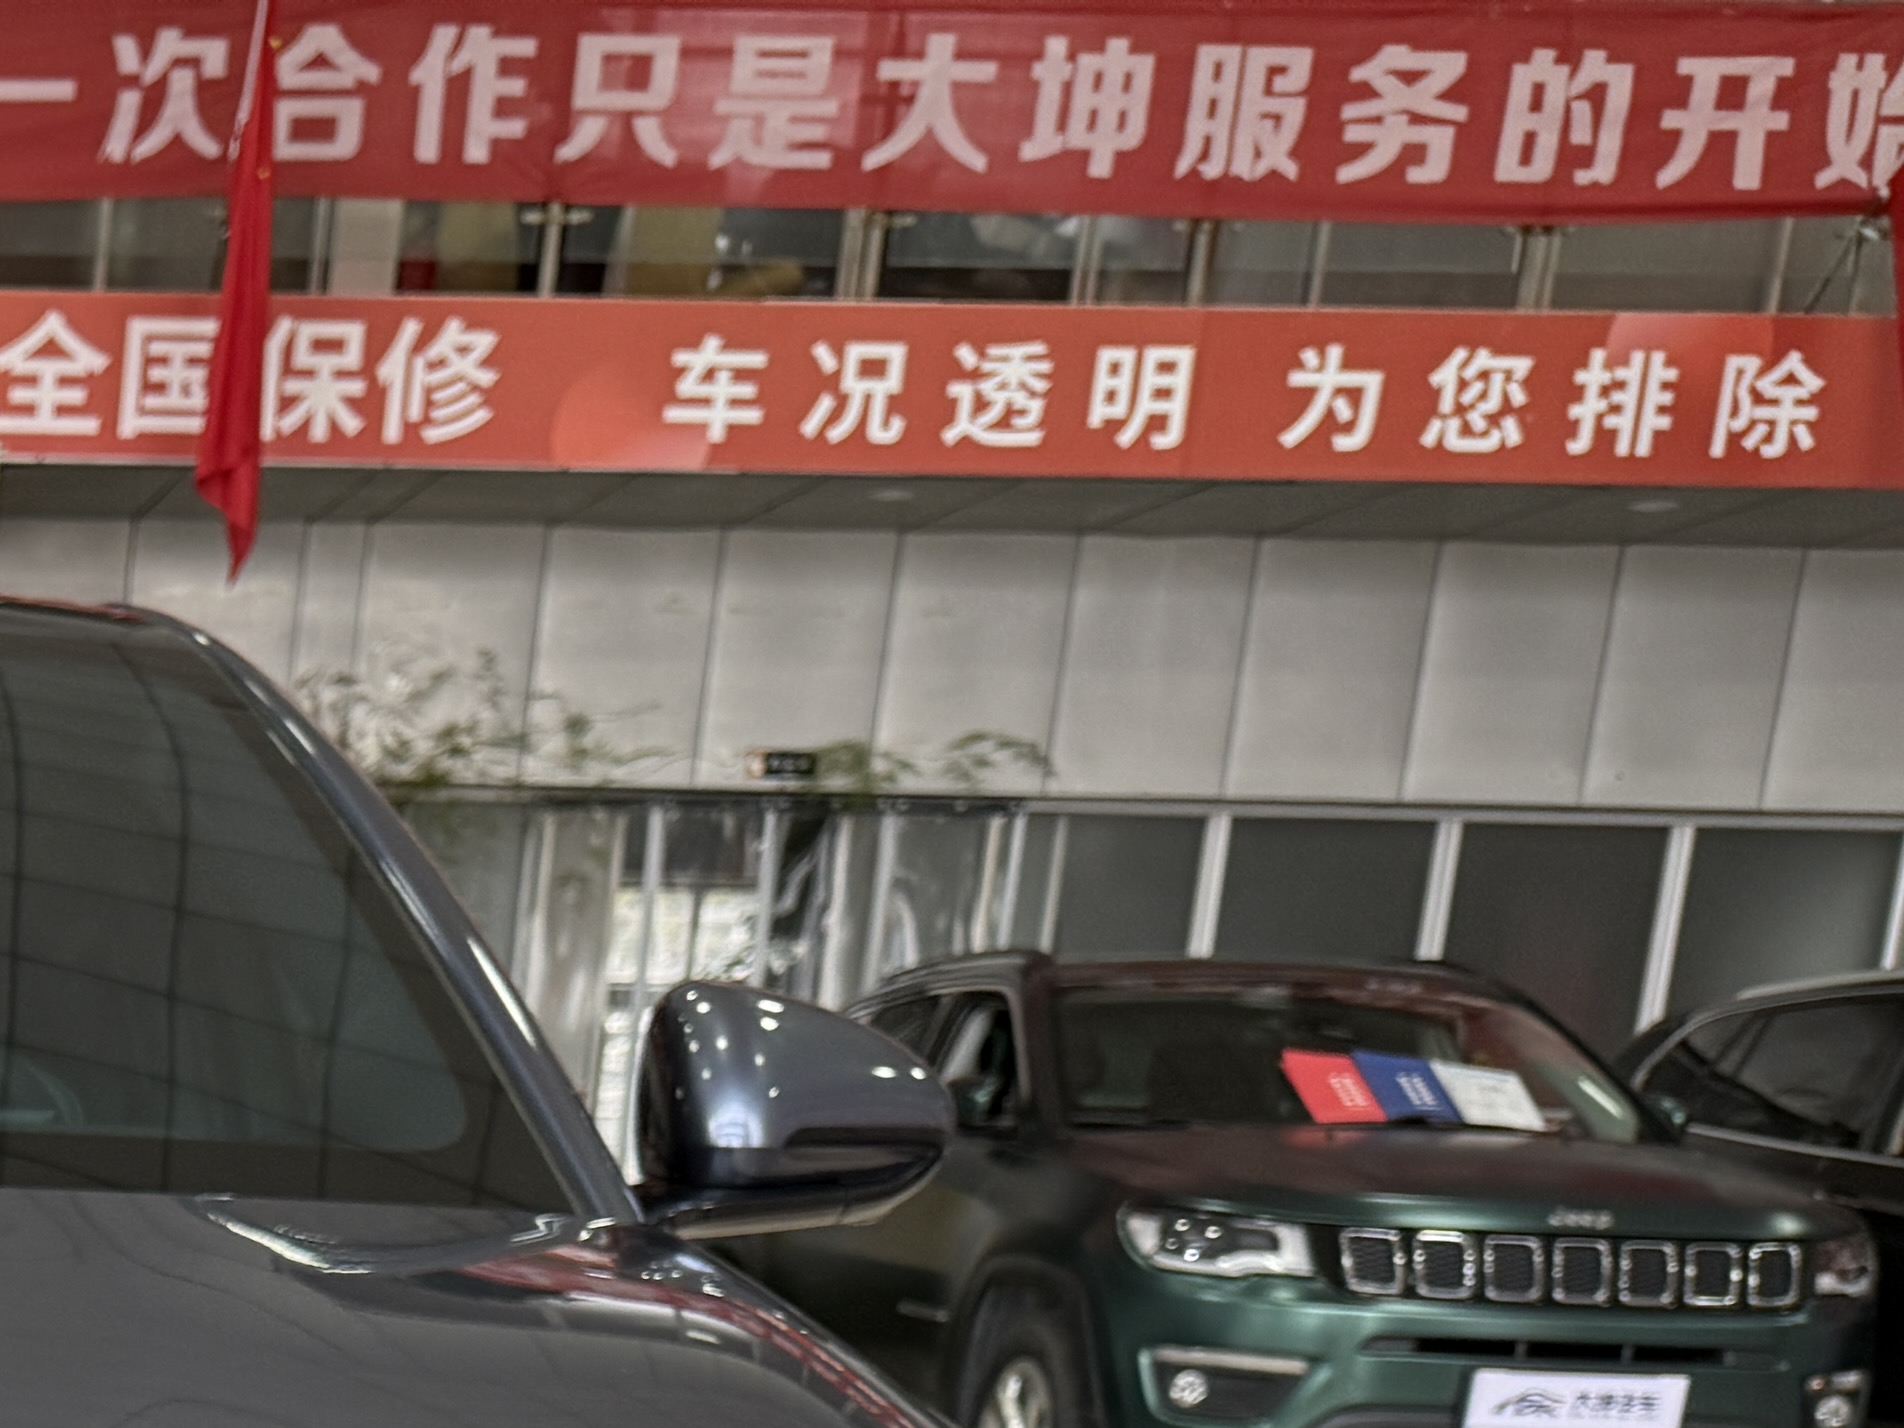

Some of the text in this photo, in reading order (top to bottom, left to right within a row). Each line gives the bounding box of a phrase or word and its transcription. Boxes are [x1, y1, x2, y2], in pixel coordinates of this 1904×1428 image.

[662, 334, 1195, 452] 车况透明
[1277, 346, 1828, 461] 为您排除
